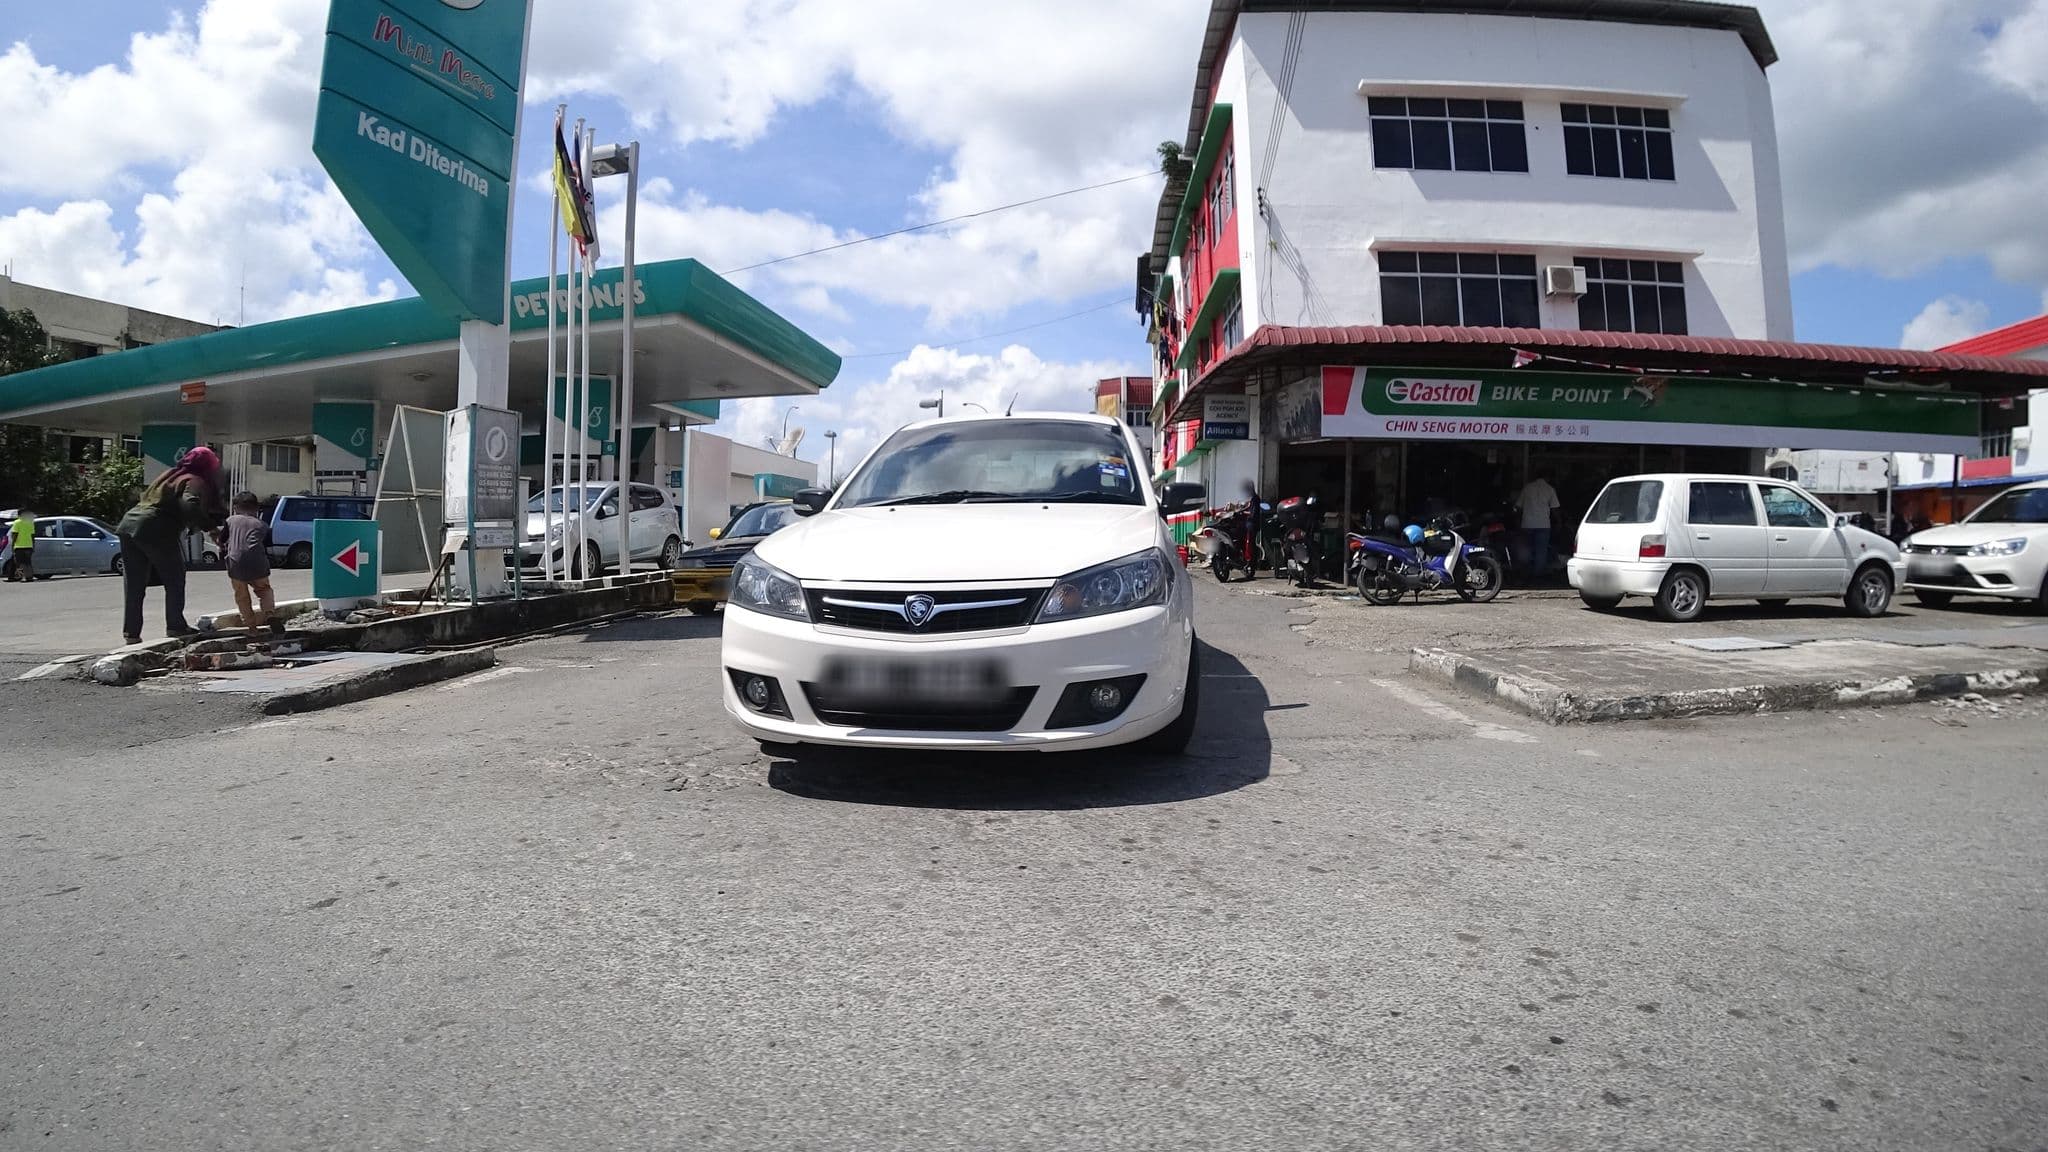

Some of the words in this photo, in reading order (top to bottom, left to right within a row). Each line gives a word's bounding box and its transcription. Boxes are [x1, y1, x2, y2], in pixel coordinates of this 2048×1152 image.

[373, 12, 433, 64] Mini
[439, 47, 495, 99] Mesra
[357, 111, 406, 153] Kad
[409, 135, 488, 197] Diterima
[1409, 382, 1475, 402] Castrol
[1492, 386, 1540, 401] BIKE
[1551, 388, 1612, 403] POINT
[1385, 420, 1418, 432] CHIN
[1421, 421, 1456, 433] SENG
[1459, 422, 1509, 435] MOTOR
